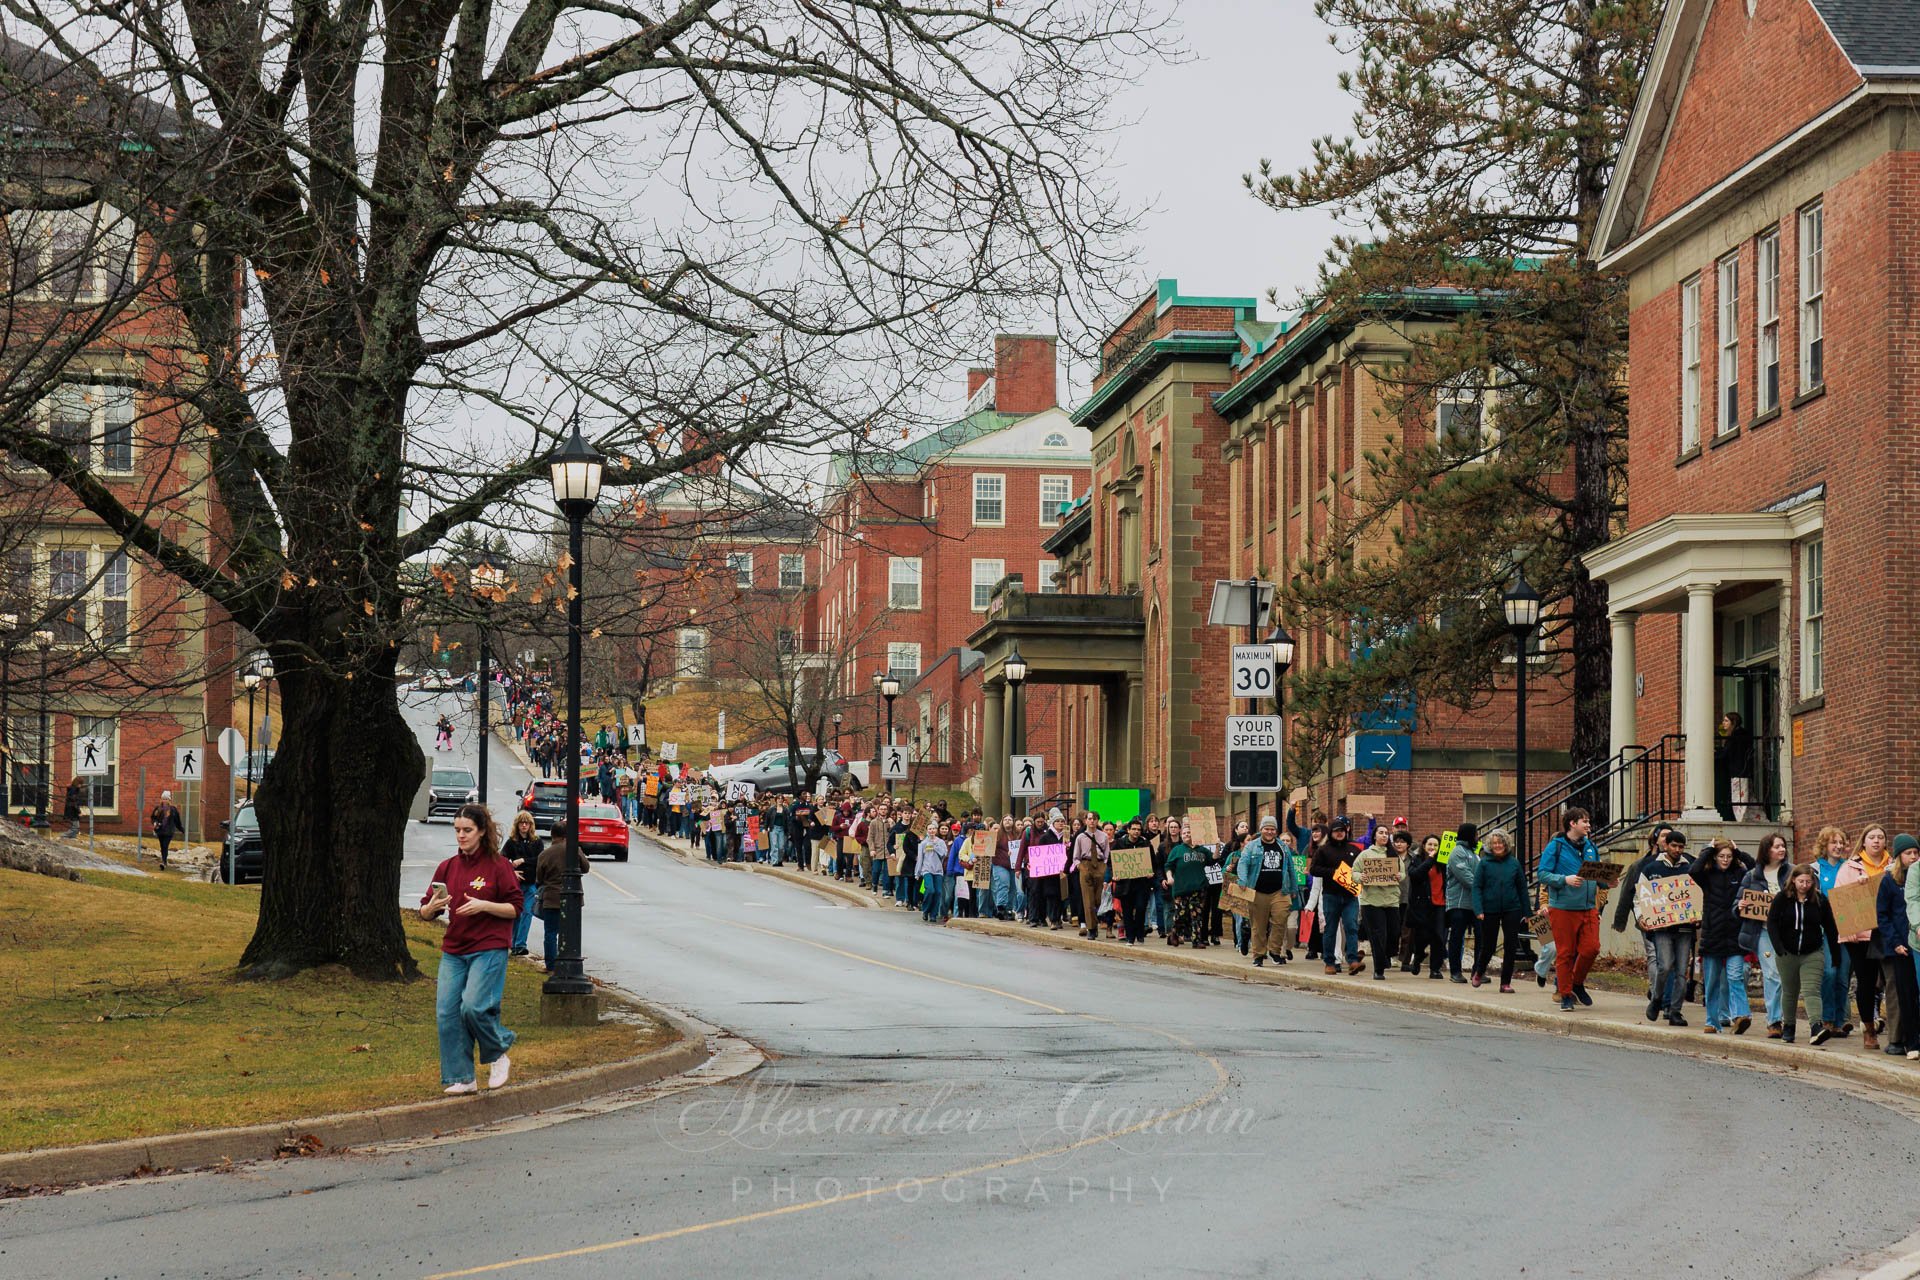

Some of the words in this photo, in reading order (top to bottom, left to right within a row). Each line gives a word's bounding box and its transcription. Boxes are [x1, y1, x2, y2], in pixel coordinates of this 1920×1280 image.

[1235, 651, 1272, 660] MAXIMUM
[1236, 667, 1271, 690] 30
[1235, 721, 1273, 732] YOUR
[1233, 735, 1275, 746] SPEED
[733, 783, 748, 793] NO
[731, 791, 750, 801] CS
[1029, 846, 1041, 858] DO
[1112, 851, 1144, 863] DON'T
[1363, 859, 1382, 867] CUTS
[1363, 867, 1393, 875] STUDENT
[1667, 889, 1690, 902] Cuts
[1744, 891, 1773, 904] FUND
